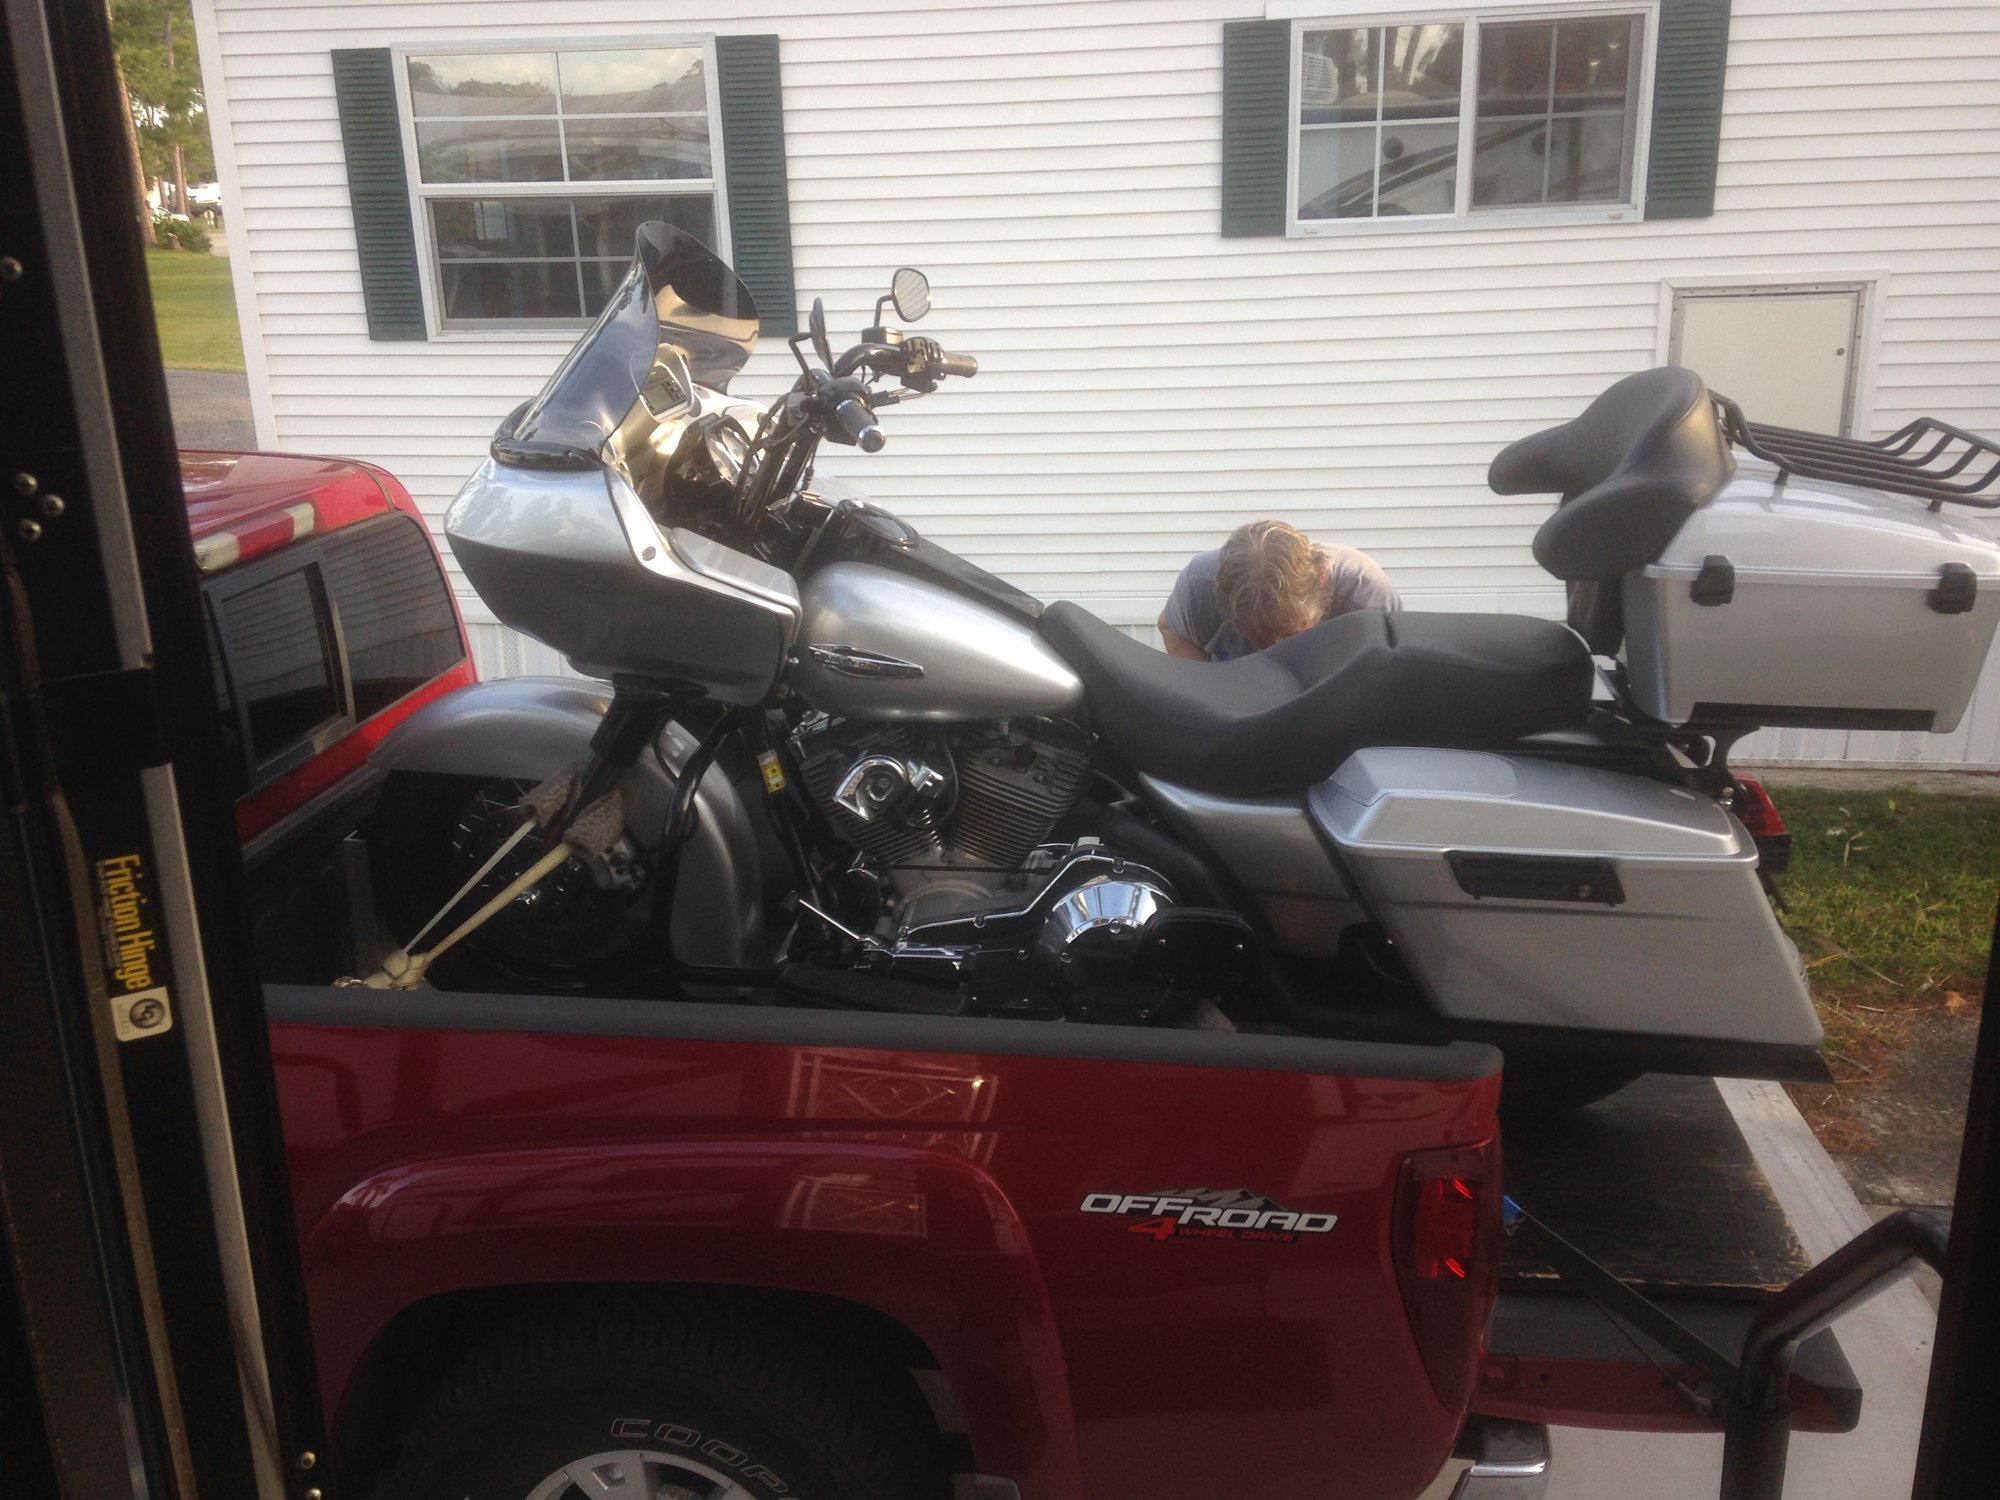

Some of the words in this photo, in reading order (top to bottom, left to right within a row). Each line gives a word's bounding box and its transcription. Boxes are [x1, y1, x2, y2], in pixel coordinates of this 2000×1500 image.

[103, 854, 148, 933] Friction
[115, 930, 156, 990] Hinge
[1127, 1217, 1178, 1241] 4
[1178, 1228, 1235, 1239] WHEEL
[1241, 1231, 1294, 1242] DRIVE
[611, 1418, 798, 1500] COOP
